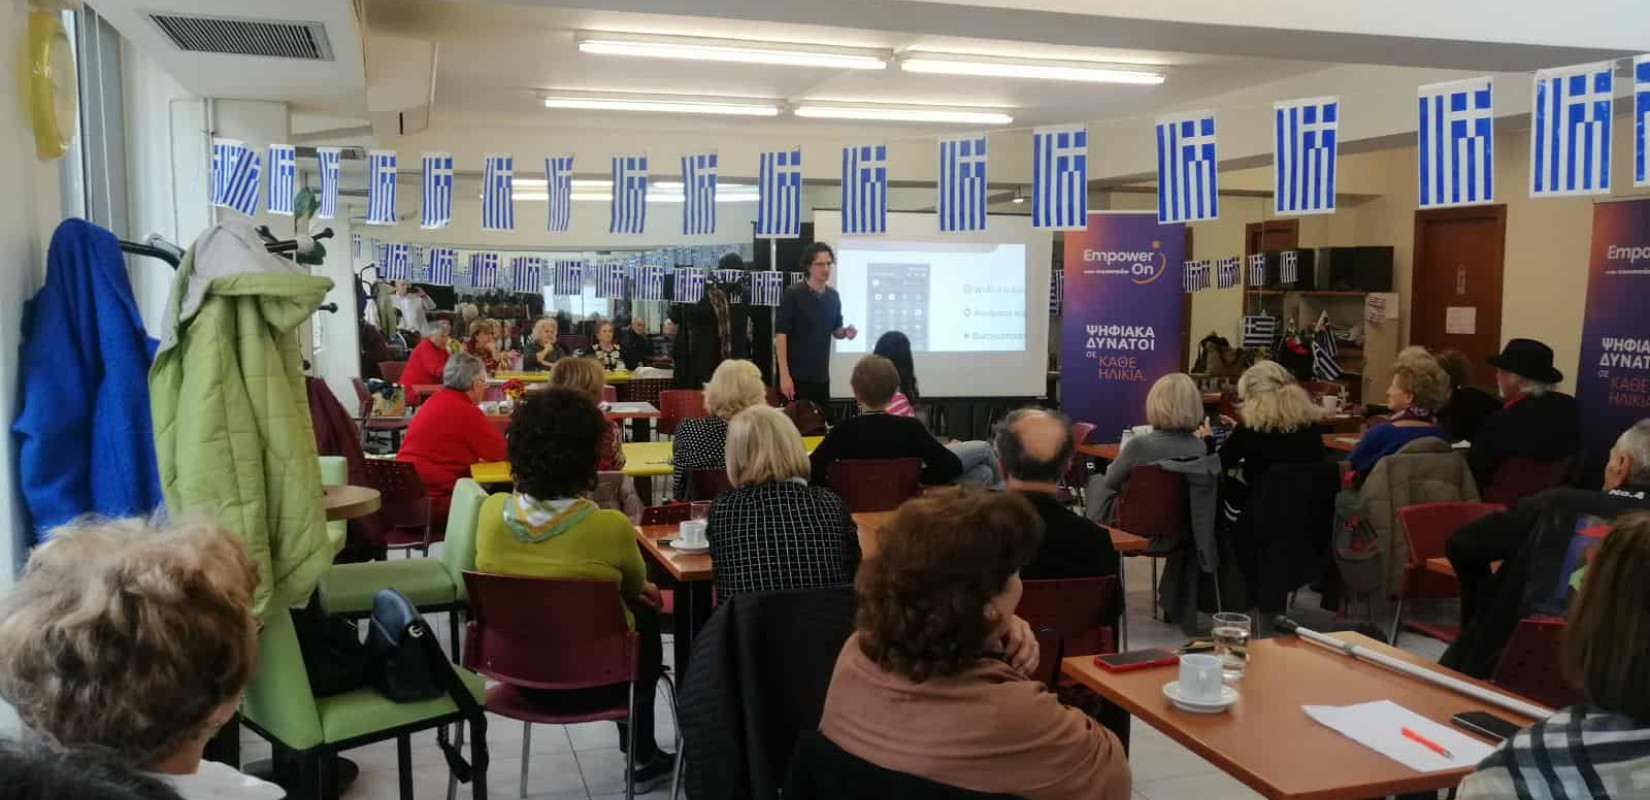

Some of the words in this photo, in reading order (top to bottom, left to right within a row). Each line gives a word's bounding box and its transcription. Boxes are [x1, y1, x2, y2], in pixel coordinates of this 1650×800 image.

[1083, 249, 1154, 265] Empower
[1132, 263, 1154, 275] On
[1086, 325, 1155, 338] ΨΗΦΙΑΚΑ
[1086, 337, 1155, 351] ΔΥΝΑΤΟΙ
[1099, 356, 1138, 369] ΚΑΘΕ
[1099, 368, 1147, 381] ΗΛΙΚΙΑ.
